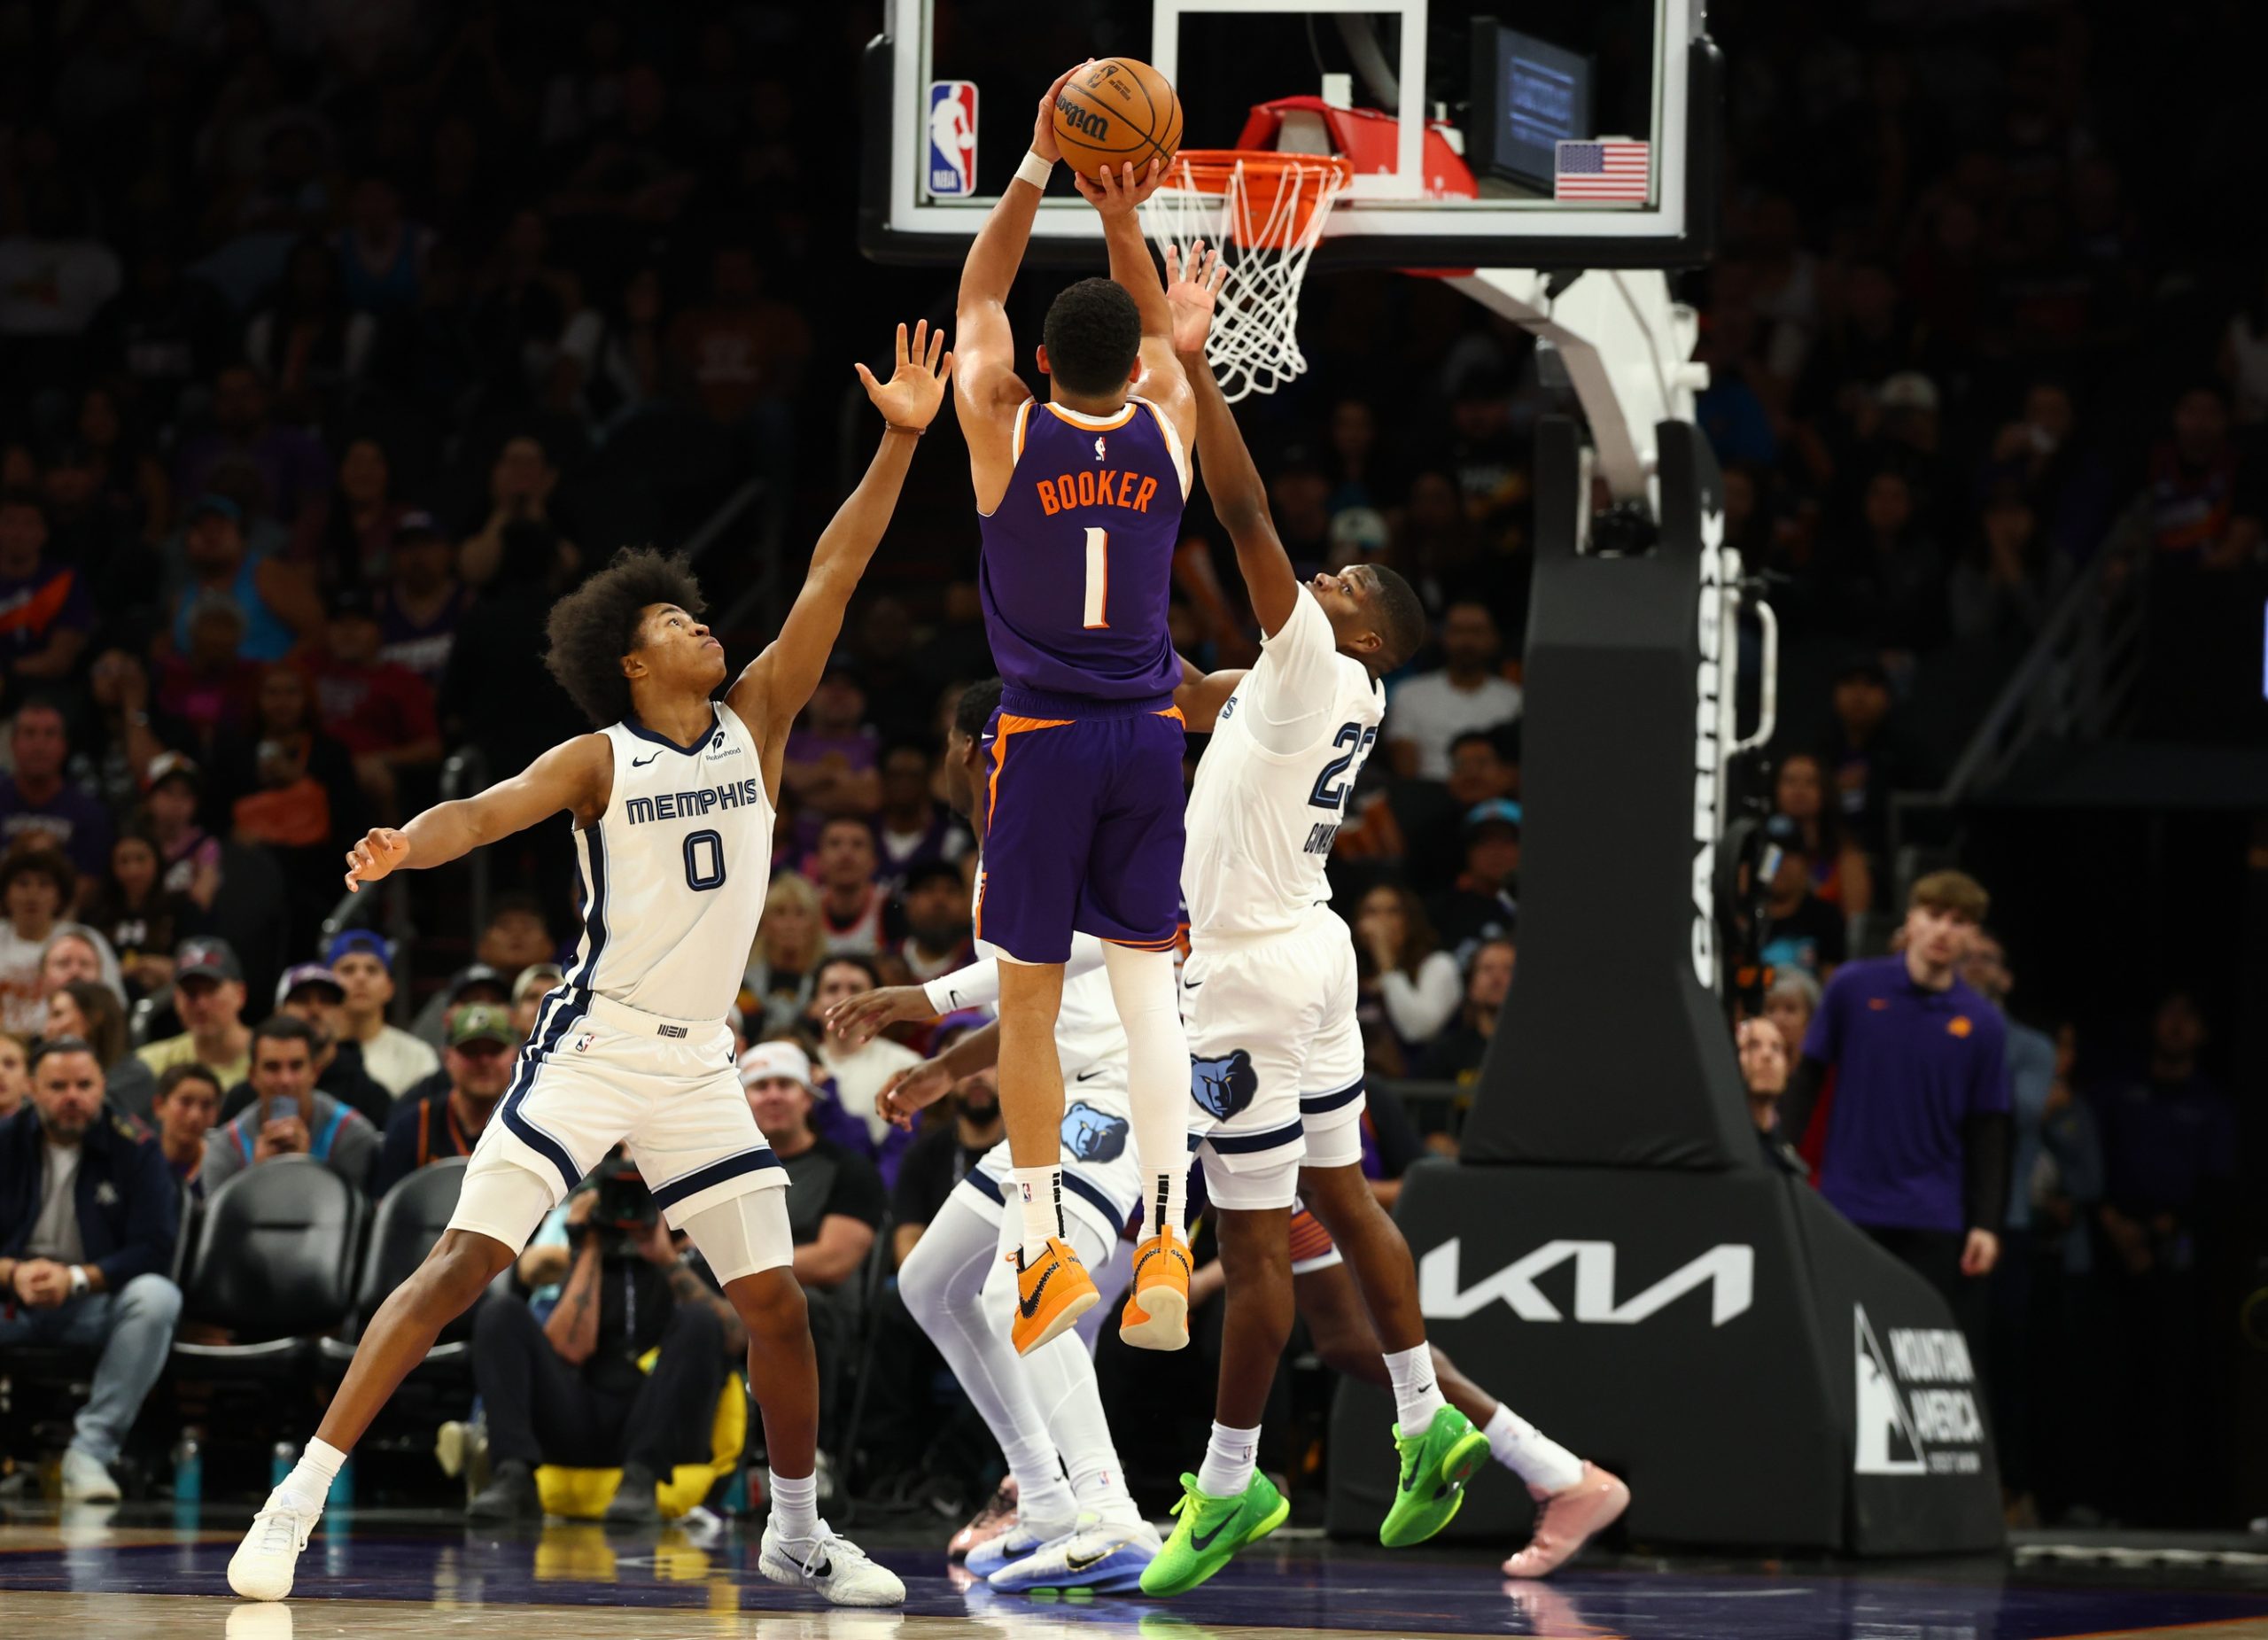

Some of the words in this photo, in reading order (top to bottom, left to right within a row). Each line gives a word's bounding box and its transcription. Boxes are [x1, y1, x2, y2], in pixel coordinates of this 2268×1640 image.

[1037, 470, 1158, 516] BOOKER
[1084, 526, 1110, 629] 1
[705, 747, 742, 762] Robinhood
[625, 778, 757, 825] MEMPHIS
[683, 829, 726, 891] 0
[1888, 1327, 1977, 1383] MOUNTAIN
[1909, 1388, 1984, 1443] AMERICA
